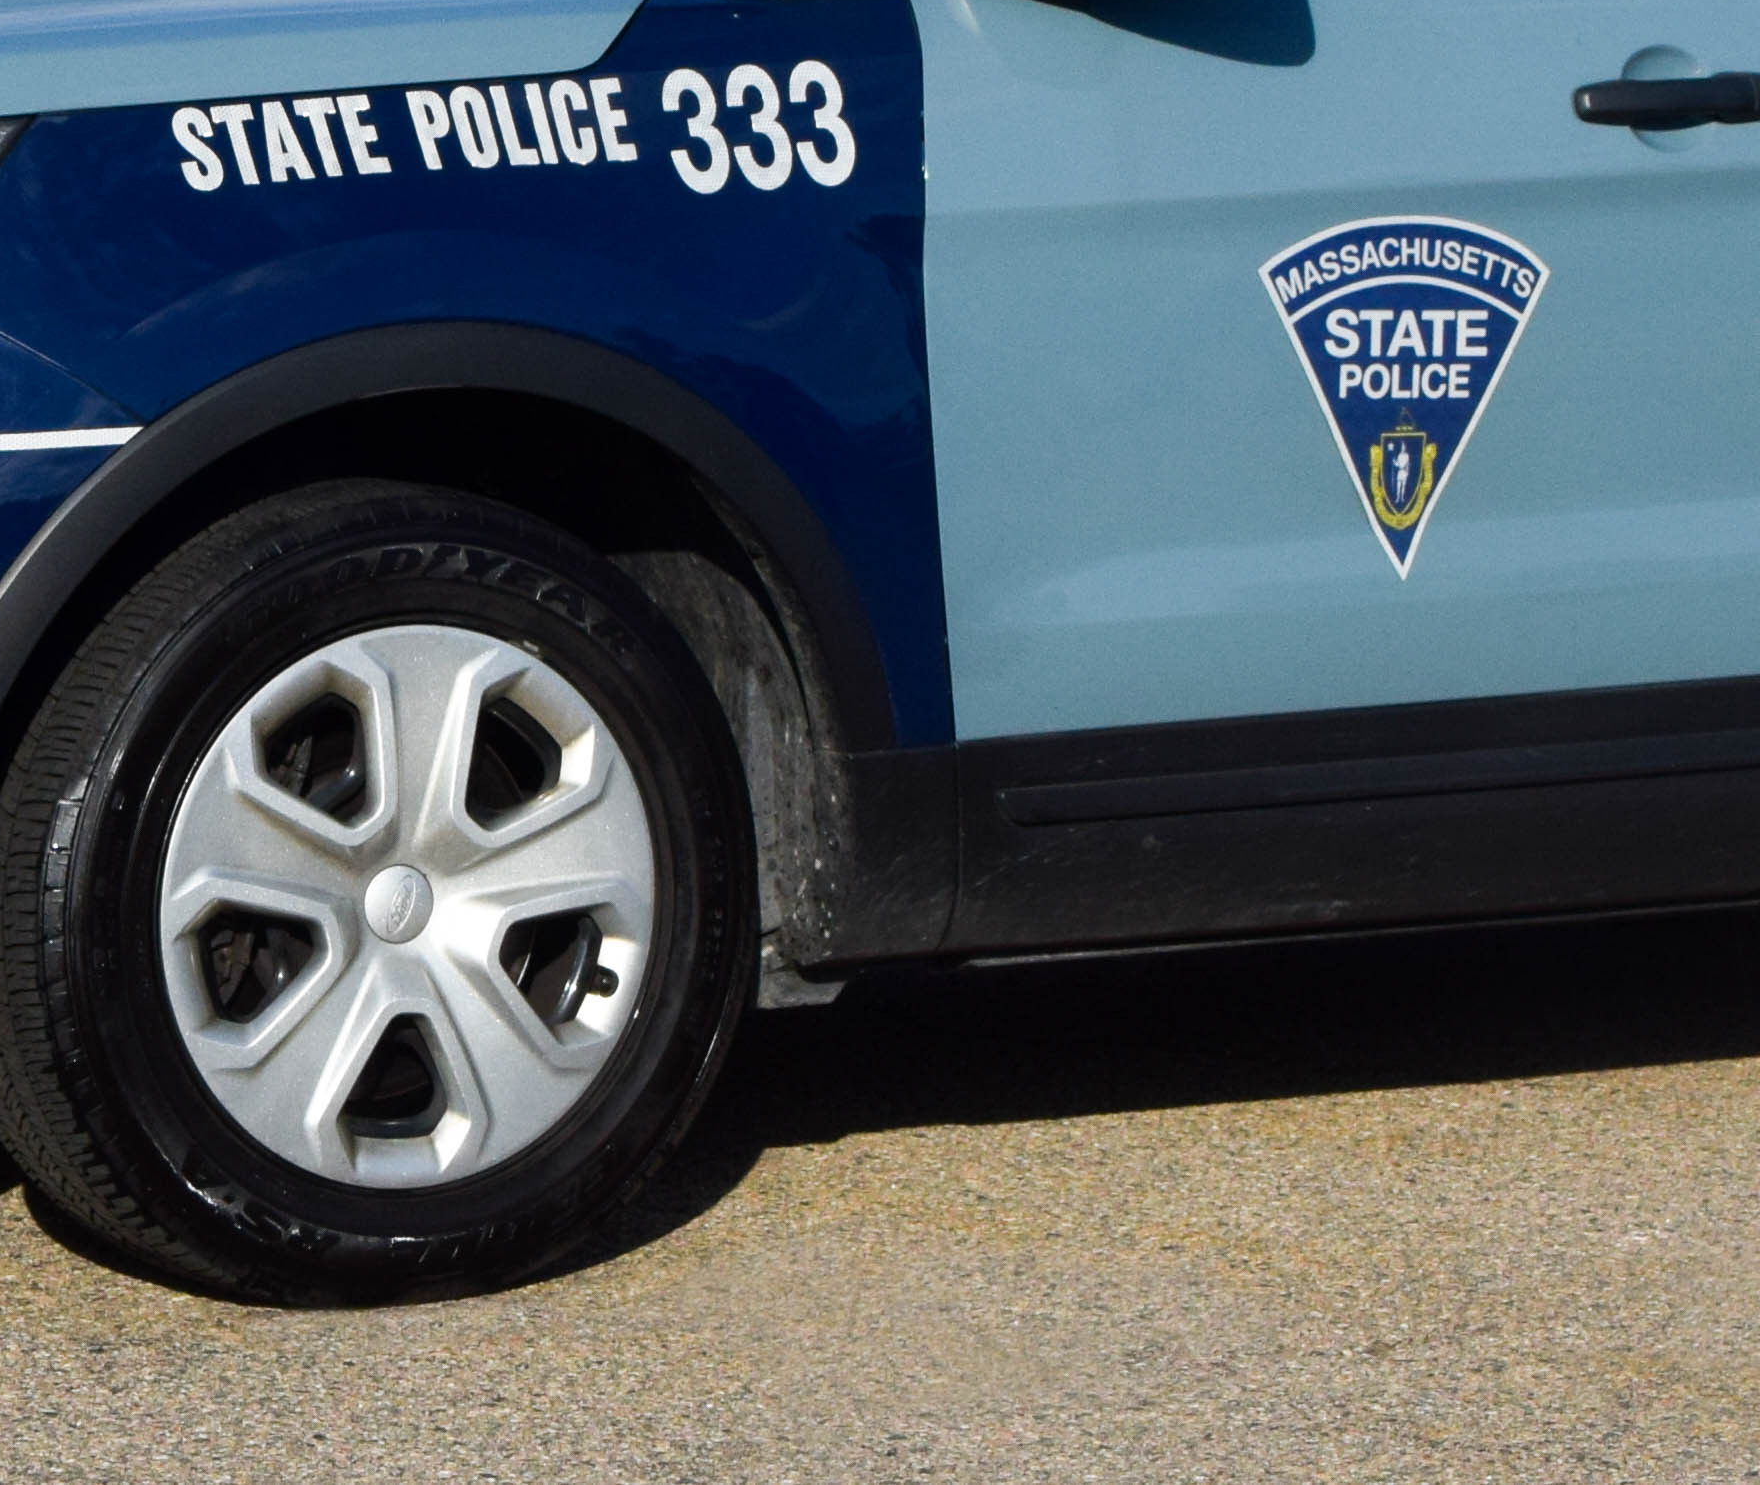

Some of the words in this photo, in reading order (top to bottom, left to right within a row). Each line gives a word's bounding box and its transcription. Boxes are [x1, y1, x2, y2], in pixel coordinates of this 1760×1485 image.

[171, 93, 392, 192] STATE
[405, 77, 638, 170] POLICE
[661, 60, 856, 195] 333
[1273, 237, 1537, 304] MASSACHUSETTS
[1324, 308, 1489, 358] STATE
[1339, 363, 1471, 400] POLICE
